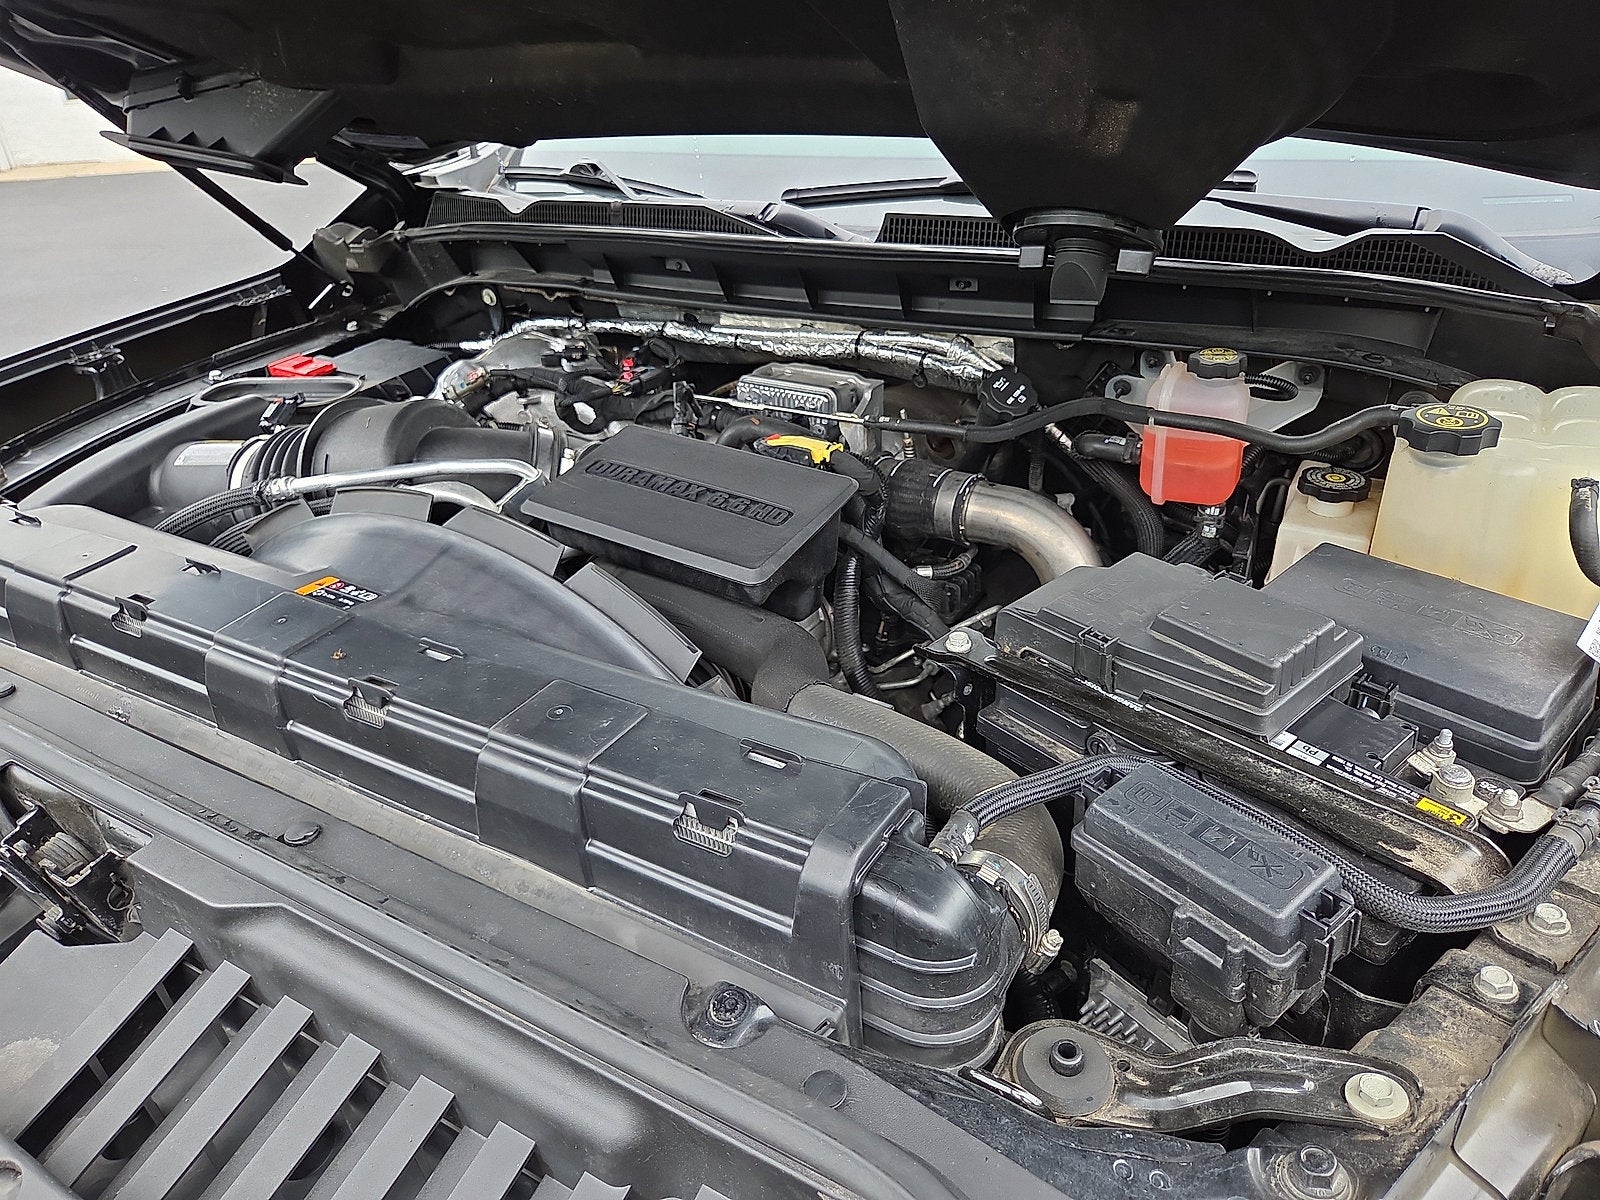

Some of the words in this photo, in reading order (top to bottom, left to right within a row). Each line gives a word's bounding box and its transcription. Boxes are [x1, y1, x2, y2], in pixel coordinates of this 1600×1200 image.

[593, 459, 707, 502] DURAMAX
[708, 491, 750, 514] 6.6
[750, 502, 789, 526] HD
[1302, 745, 1319, 756] Pb
